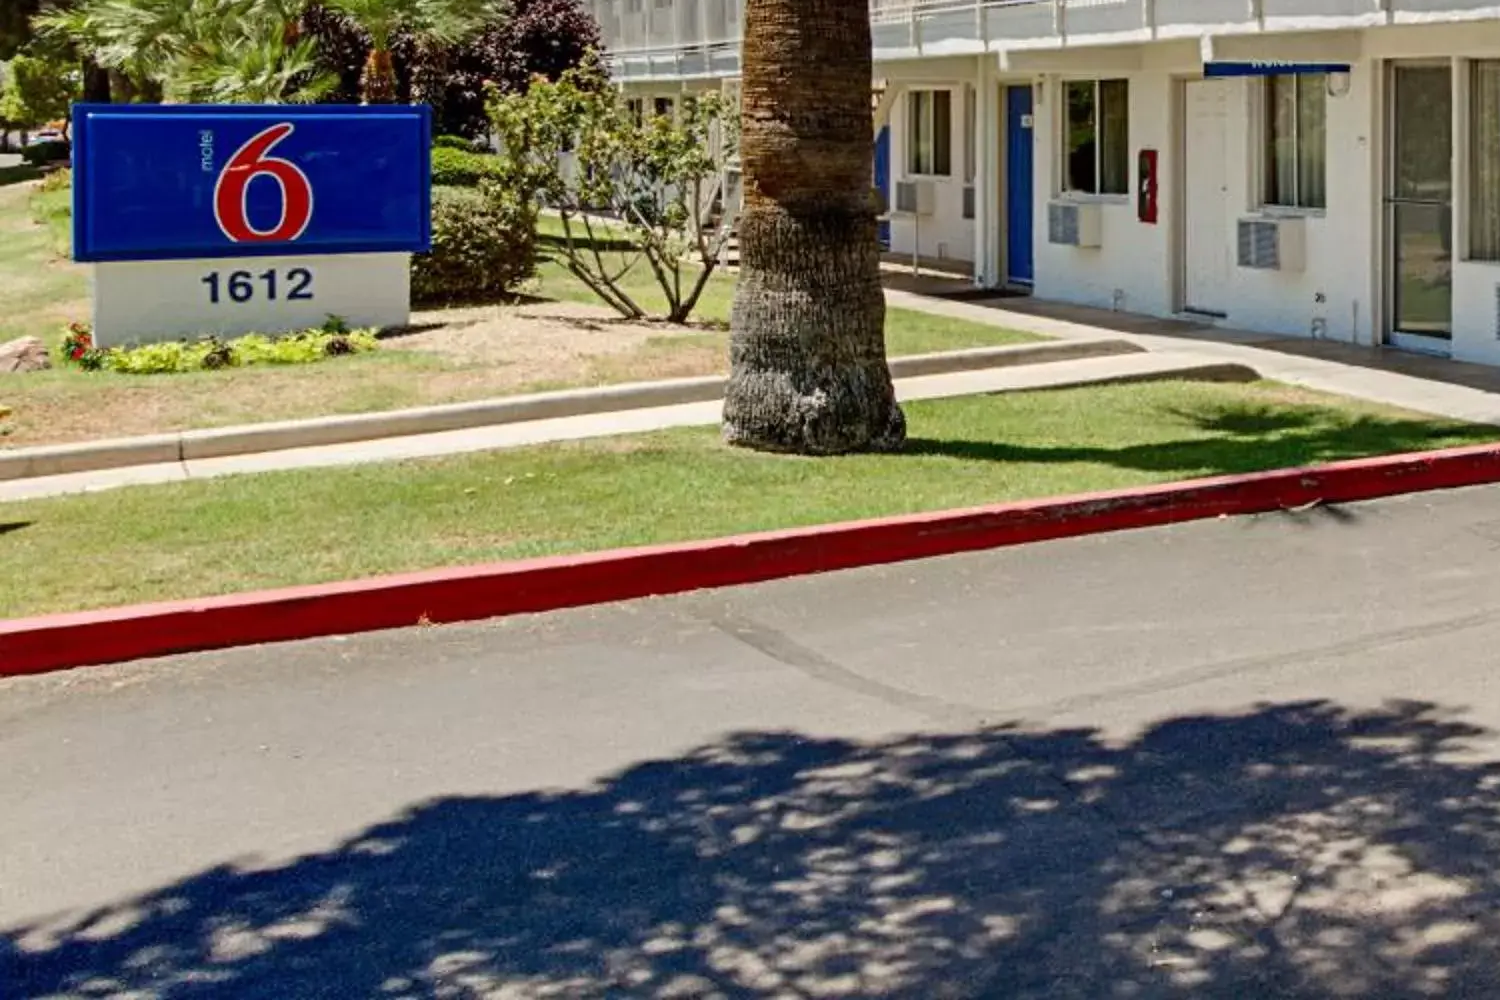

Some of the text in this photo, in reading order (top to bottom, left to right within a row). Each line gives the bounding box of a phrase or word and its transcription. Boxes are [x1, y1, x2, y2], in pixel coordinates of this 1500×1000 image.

[199, 122, 314, 243] motel 6
[201, 267, 314, 303] 1612
